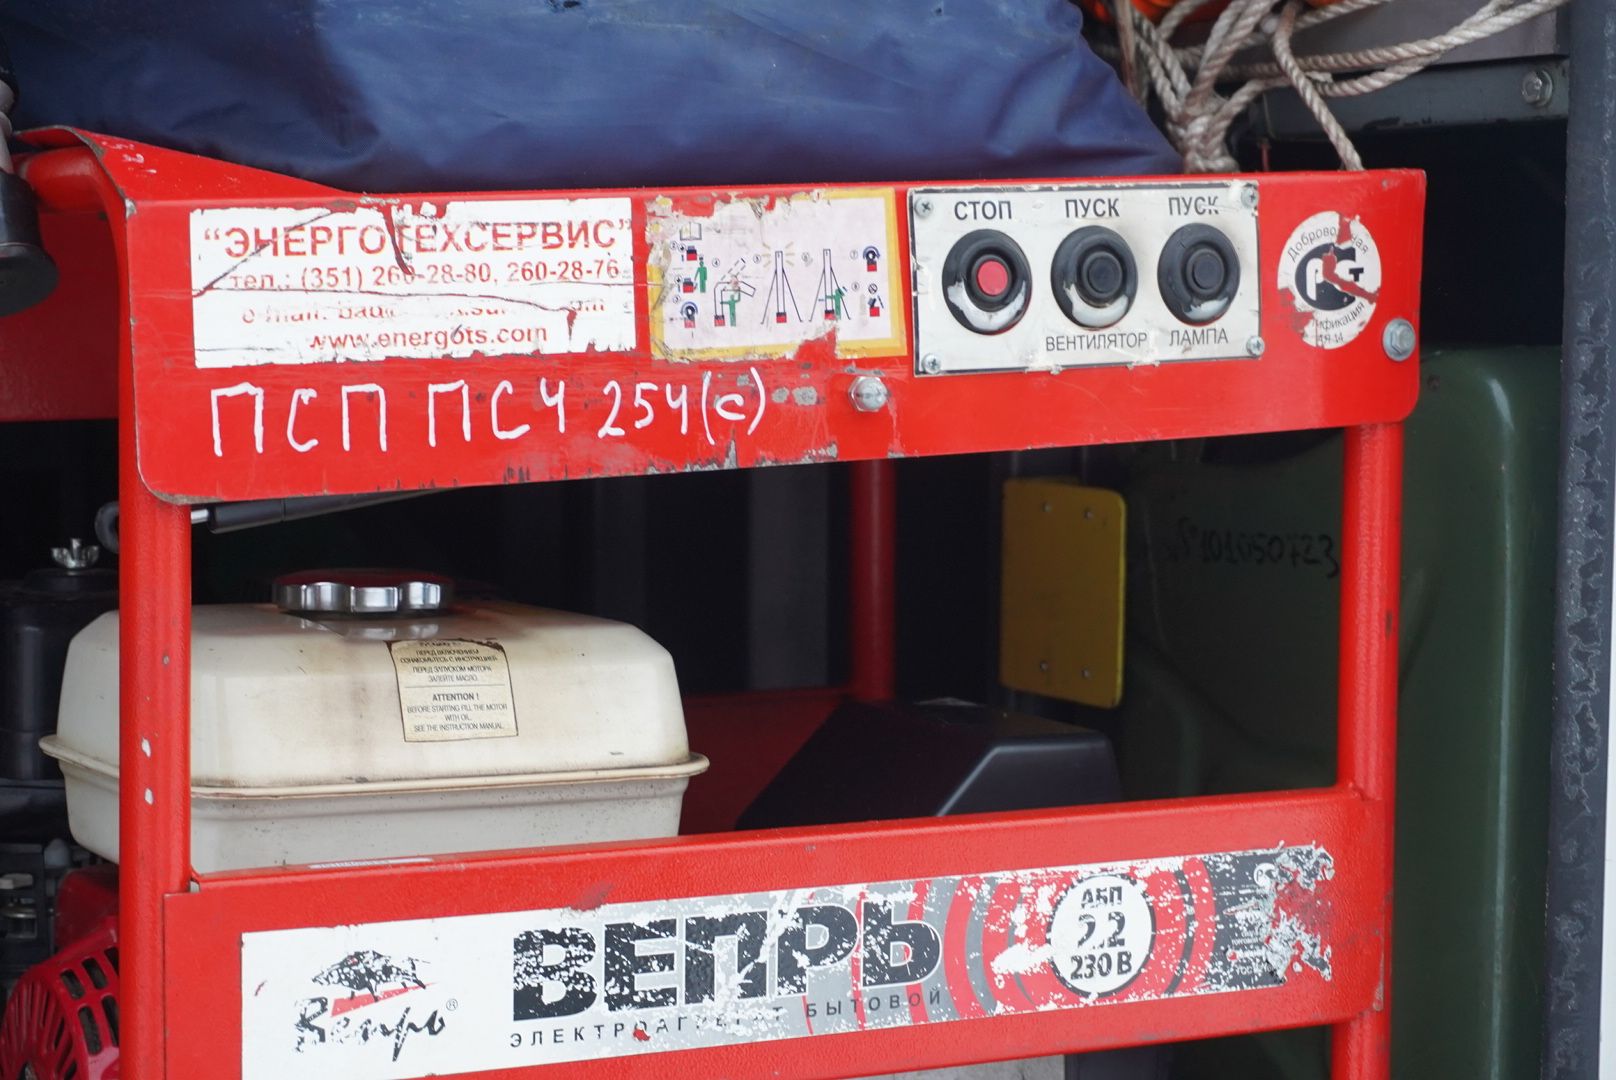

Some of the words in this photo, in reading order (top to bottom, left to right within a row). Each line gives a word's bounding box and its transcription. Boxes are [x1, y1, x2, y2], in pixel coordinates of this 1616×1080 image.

[954, 201, 1012, 220] СТОП
[1065, 198, 1120, 218] ПУСК
[1168, 196, 1220, 216] ПУСК
[301, 266, 363, 294] (351)
[1046, 332, 1148, 352] ВЕНТИЛЯТОР
[1169, 328, 1229, 347] ЛАМПА
[432, 692, 475, 701] ATTENTION
[407, 705, 431, 713] BEFORE
[432, 704, 460, 712] STARTING
[474, 703, 485, 711] THE
[486, 703, 507, 711] MOTOR
[414, 724, 426, 732] SEE
[427, 724, 439, 732] THE
[440, 723, 478, 732] INSTRUCTION
[513, 900, 942, 1021] ВЕПРЬ
[1070, 952, 1112, 980] 230
[805, 986, 940, 1018] БЫТОВОЙ
